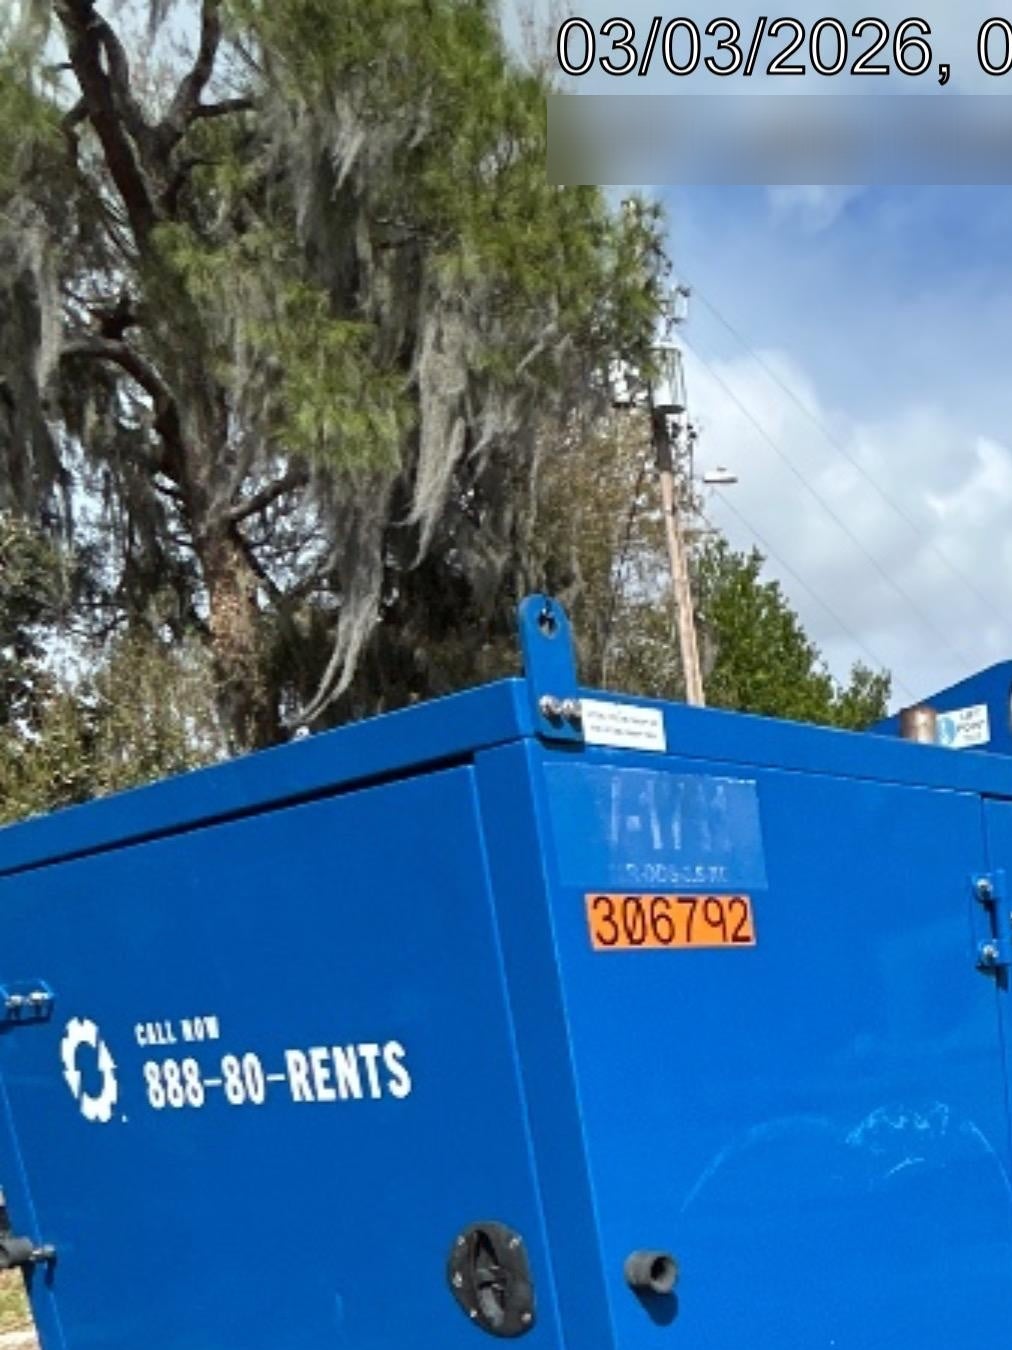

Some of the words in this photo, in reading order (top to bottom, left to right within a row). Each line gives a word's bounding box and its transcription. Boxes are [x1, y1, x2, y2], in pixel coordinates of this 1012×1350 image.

[592, 896, 752, 945] 306792
[134, 1020, 177, 1047] CALL
[180, 1015, 220, 1042] NOW
[143, 1040, 412, 1109] 888-80-RENTS
